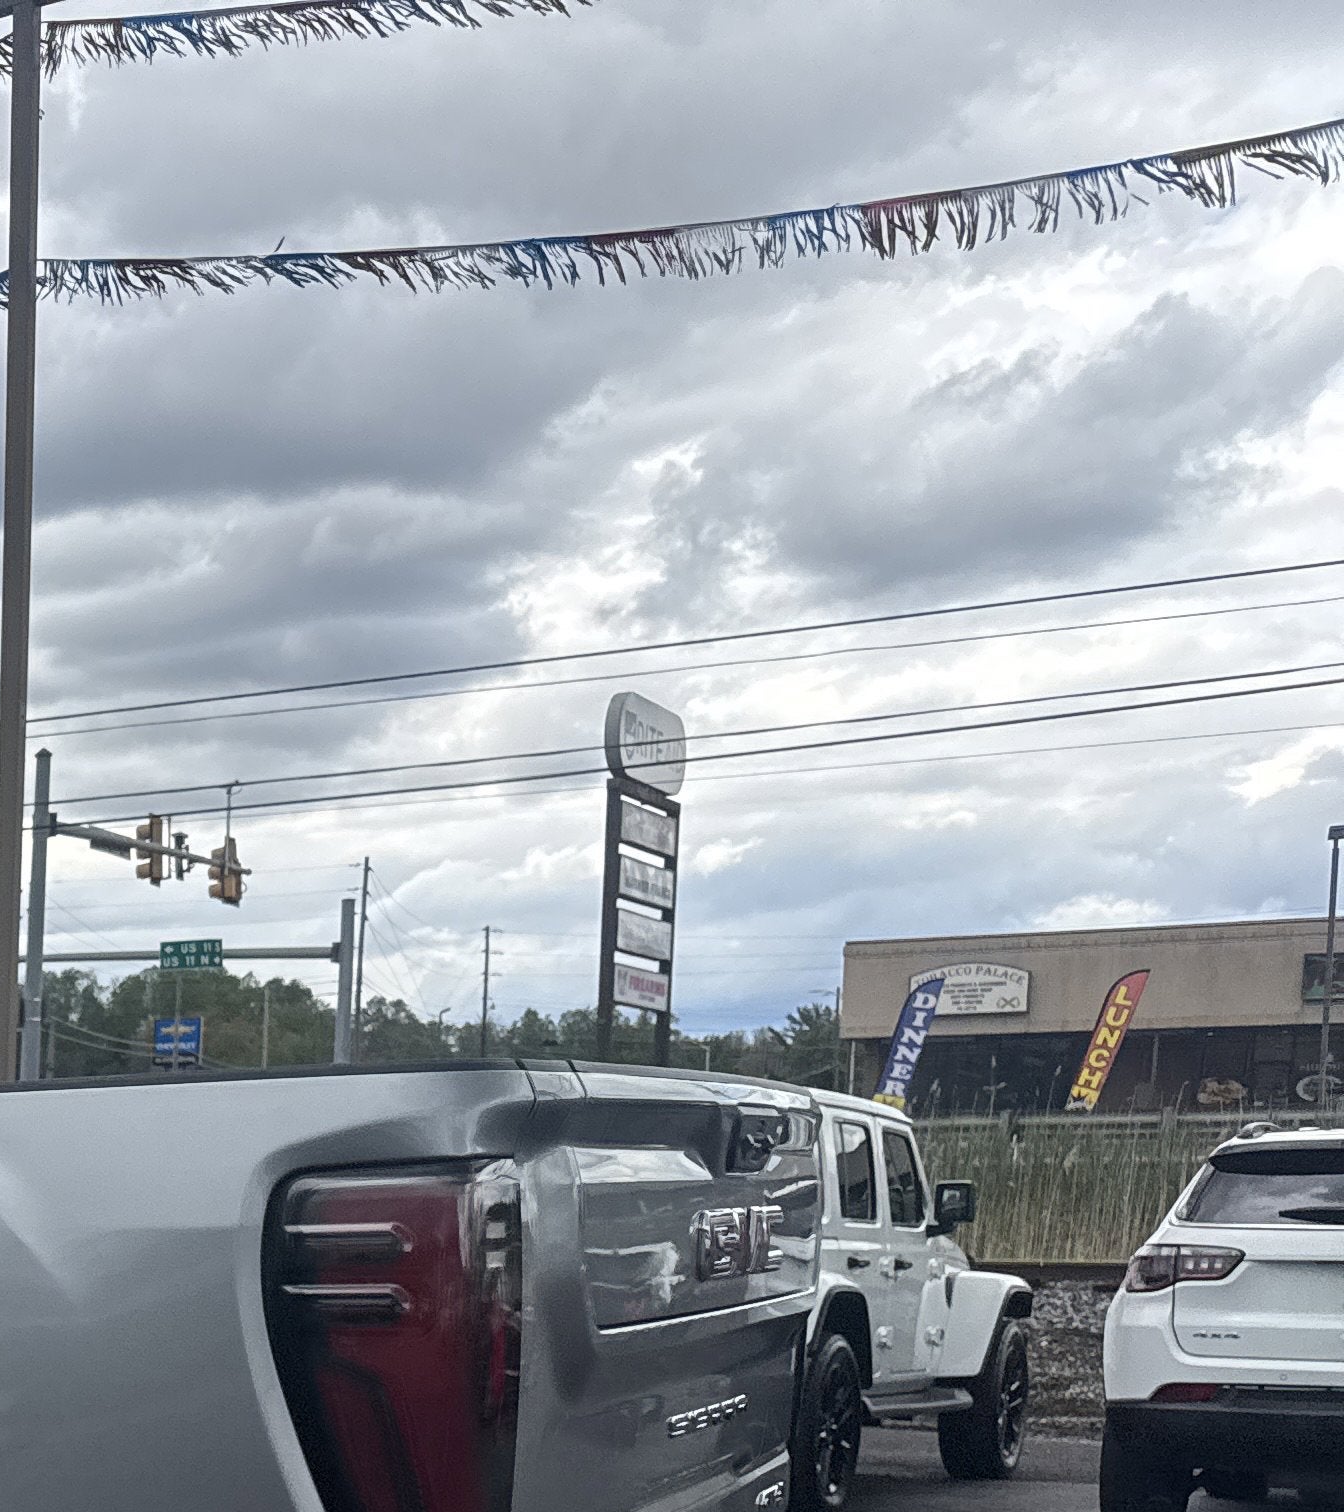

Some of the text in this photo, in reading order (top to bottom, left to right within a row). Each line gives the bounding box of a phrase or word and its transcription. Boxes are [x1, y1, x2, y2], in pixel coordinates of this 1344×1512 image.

[180, 943, 197, 954] US
[163, 955, 209, 967] US 11 N
[975, 965, 1026, 986] PALACE
[883, 991, 937, 1098] DINNER
[1077, 985, 1132, 1090] LUNCH
